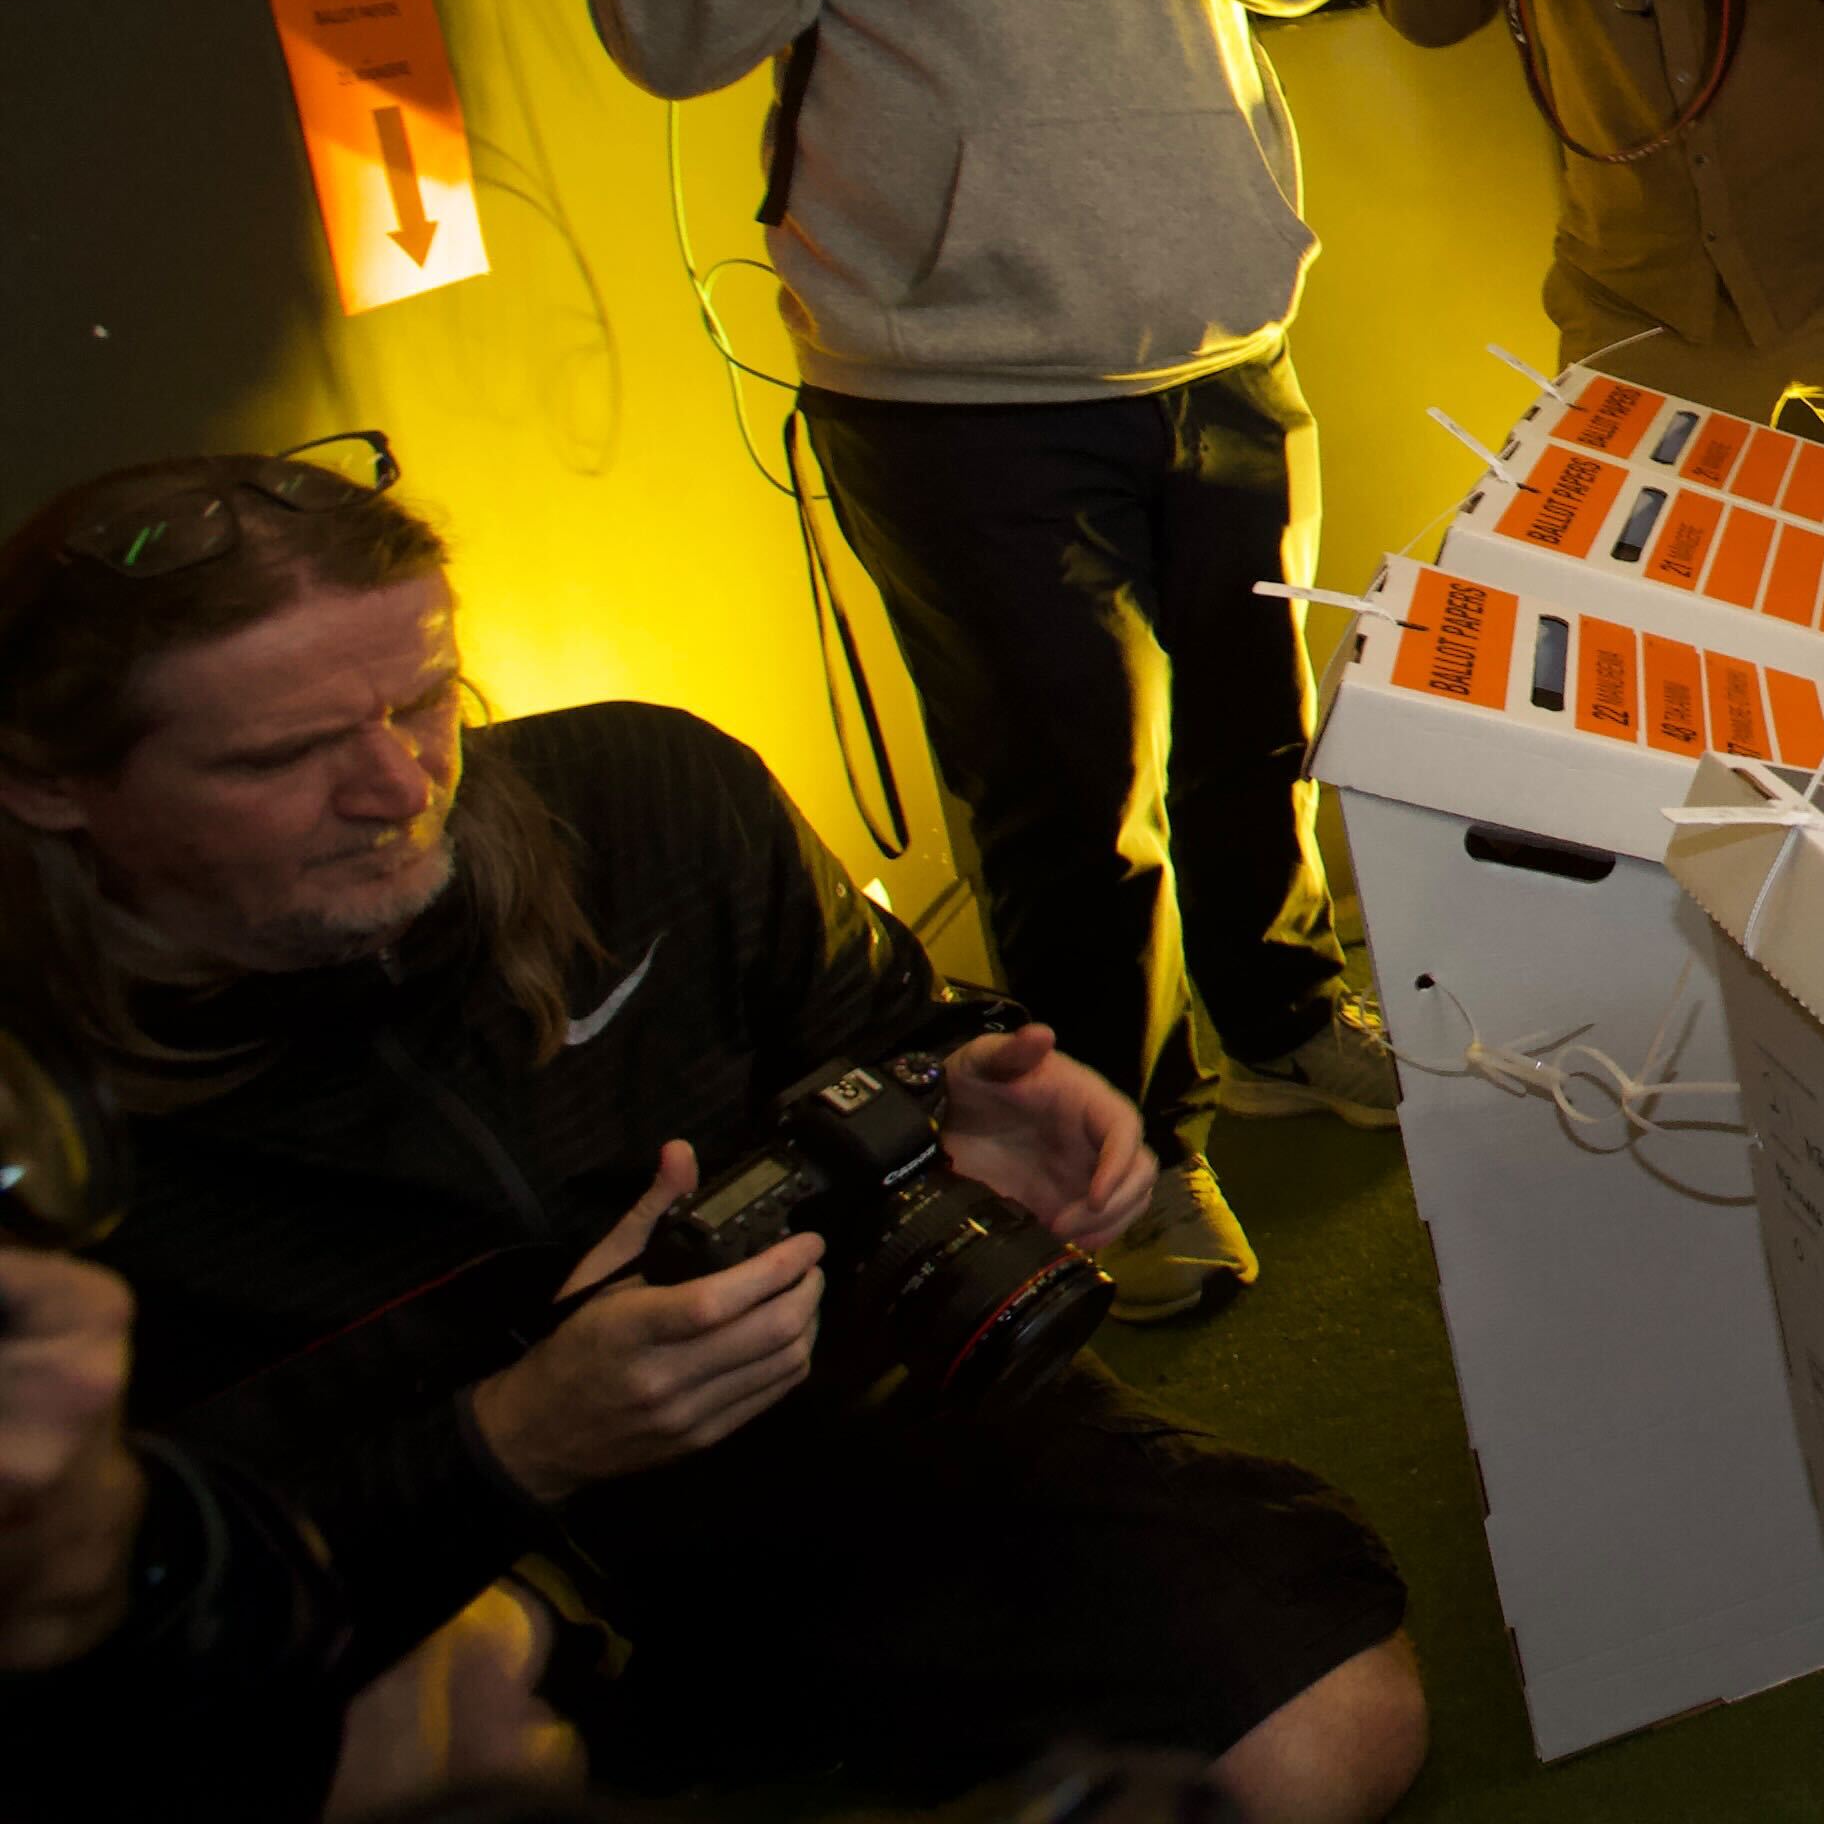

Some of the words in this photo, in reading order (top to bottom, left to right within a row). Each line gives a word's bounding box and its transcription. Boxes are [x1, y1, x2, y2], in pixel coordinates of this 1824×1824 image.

[1579, 412, 1621, 449] BALLOT
[1604, 386, 1641, 424] PAPERS
[1527, 496, 1576, 546] BALLOT
[1556, 457, 1602, 505] PAPERS
[1661, 560, 1692, 578] 21
[1441, 582, 1488, 644] PAPERS
[1430, 634, 1475, 696] BALLOT
[1592, 705, 1630, 727] 22
[1660, 722, 1697, 744] 48
[882, 1143, 937, 1186] Canon
